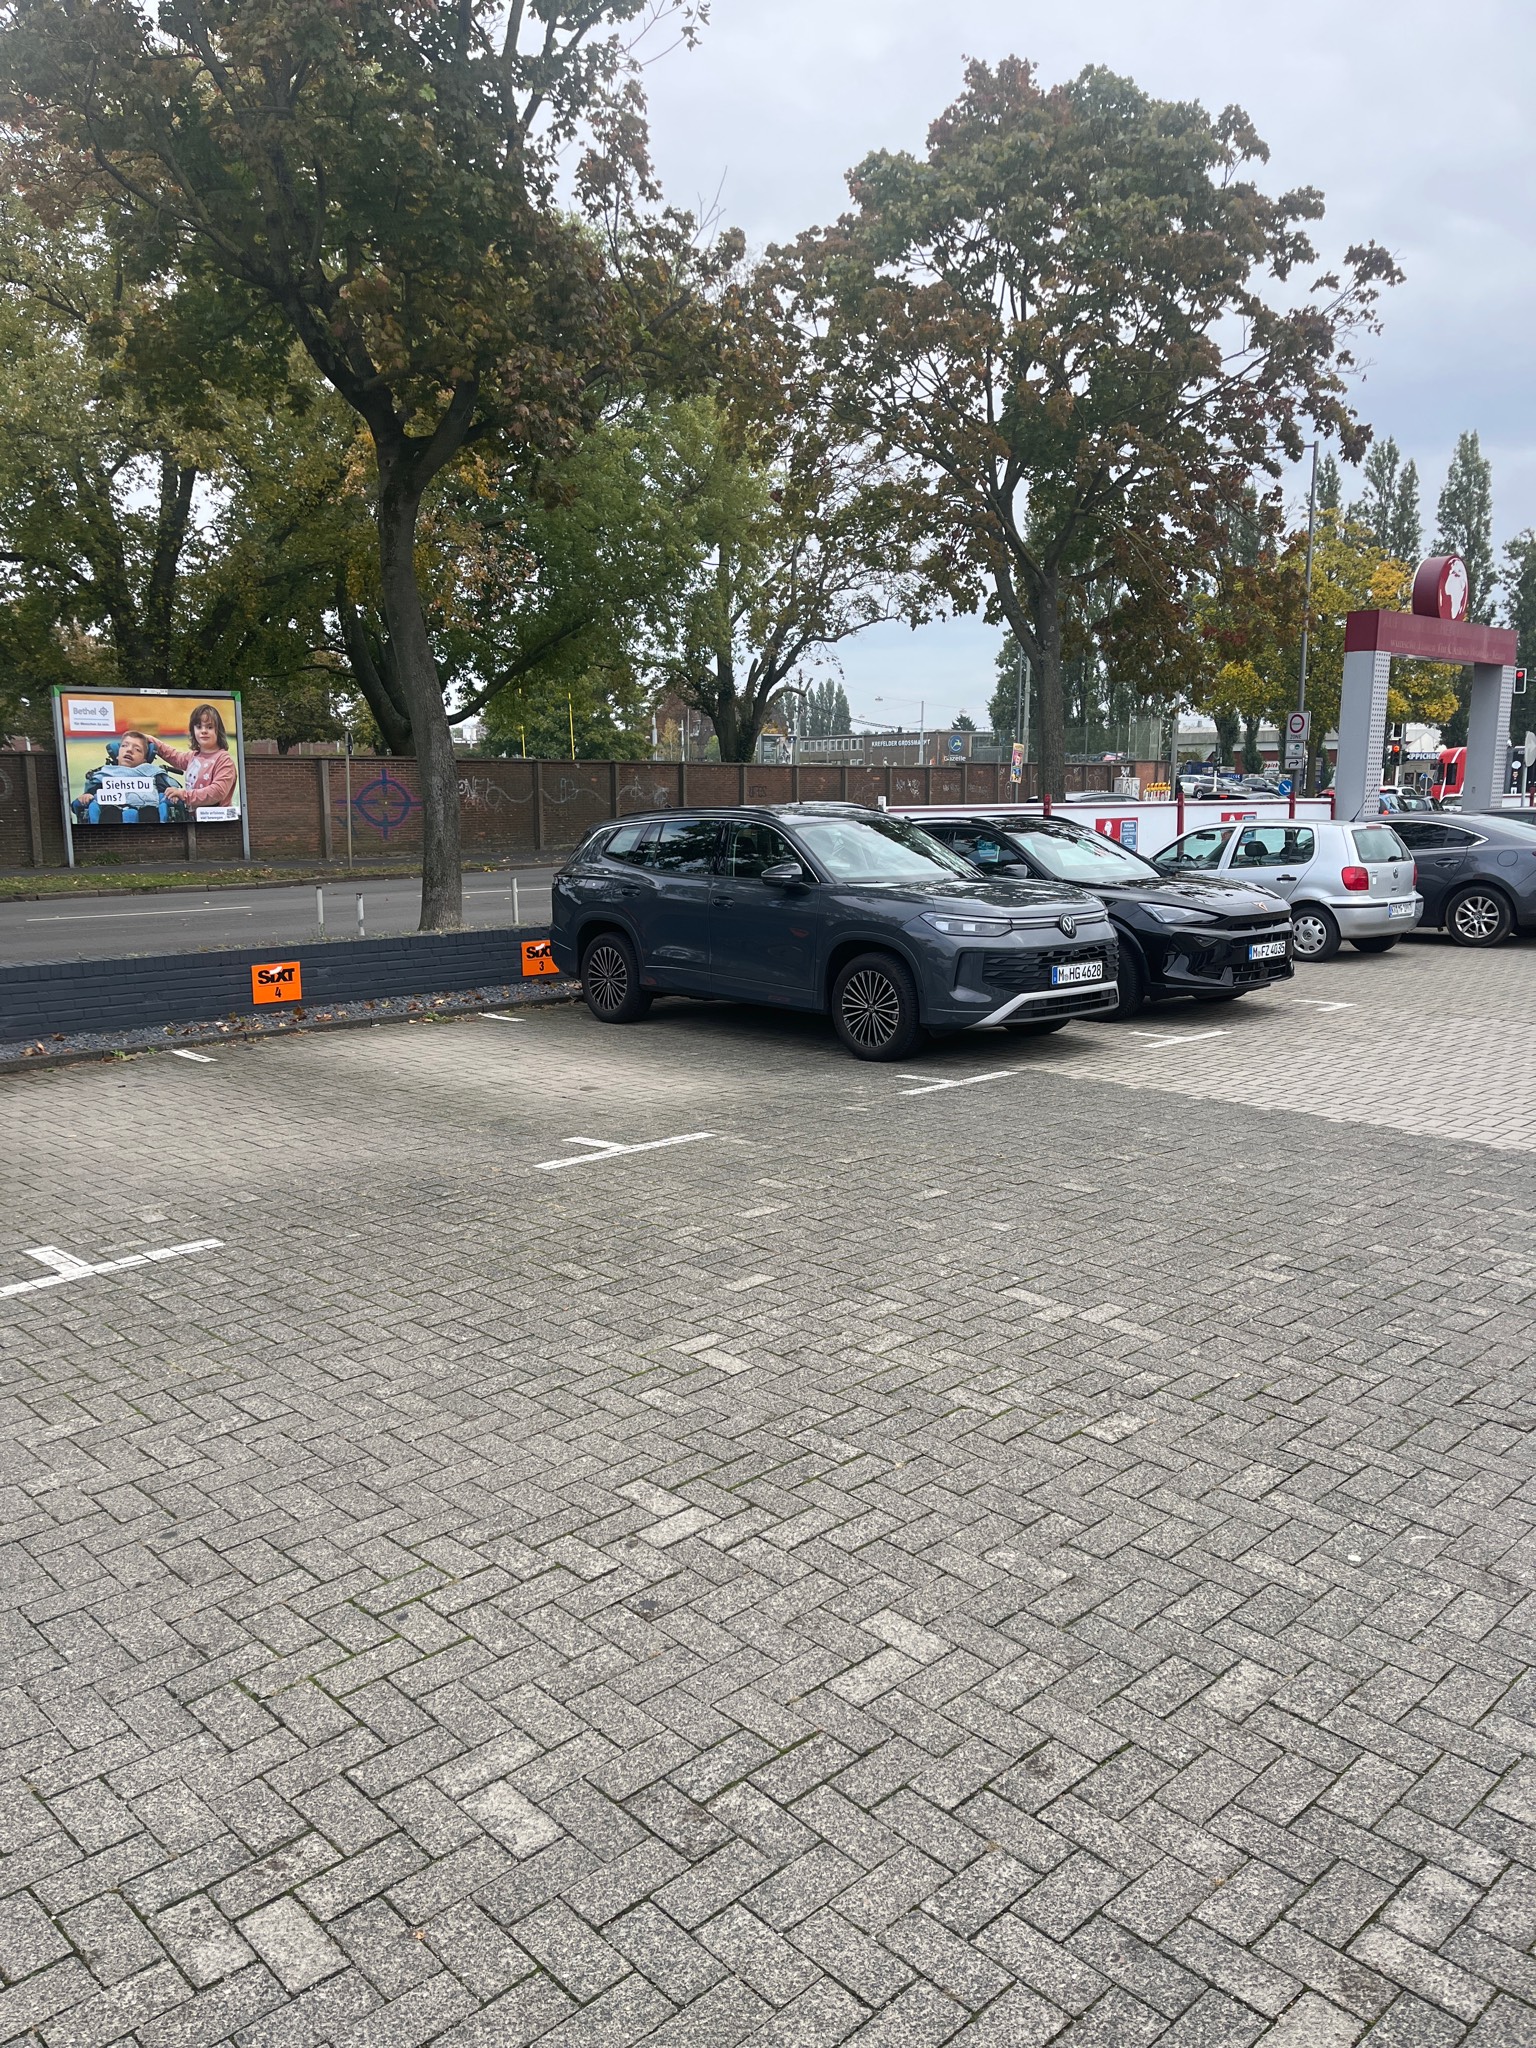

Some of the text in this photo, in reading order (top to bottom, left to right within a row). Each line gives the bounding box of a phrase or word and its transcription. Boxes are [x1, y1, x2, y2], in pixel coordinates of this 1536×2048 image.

[73, 707, 97, 715] Bethel
[105, 780, 150, 790] Siehst Du
[100, 792, 122, 801] uns?
[1261, 945, 1270, 956] FZ
[538, 960, 545, 971] 3
[257, 965, 295, 985] SIXT
[1058, 964, 1102, 982] M HG 4628
[274, 986, 282, 998] 4
